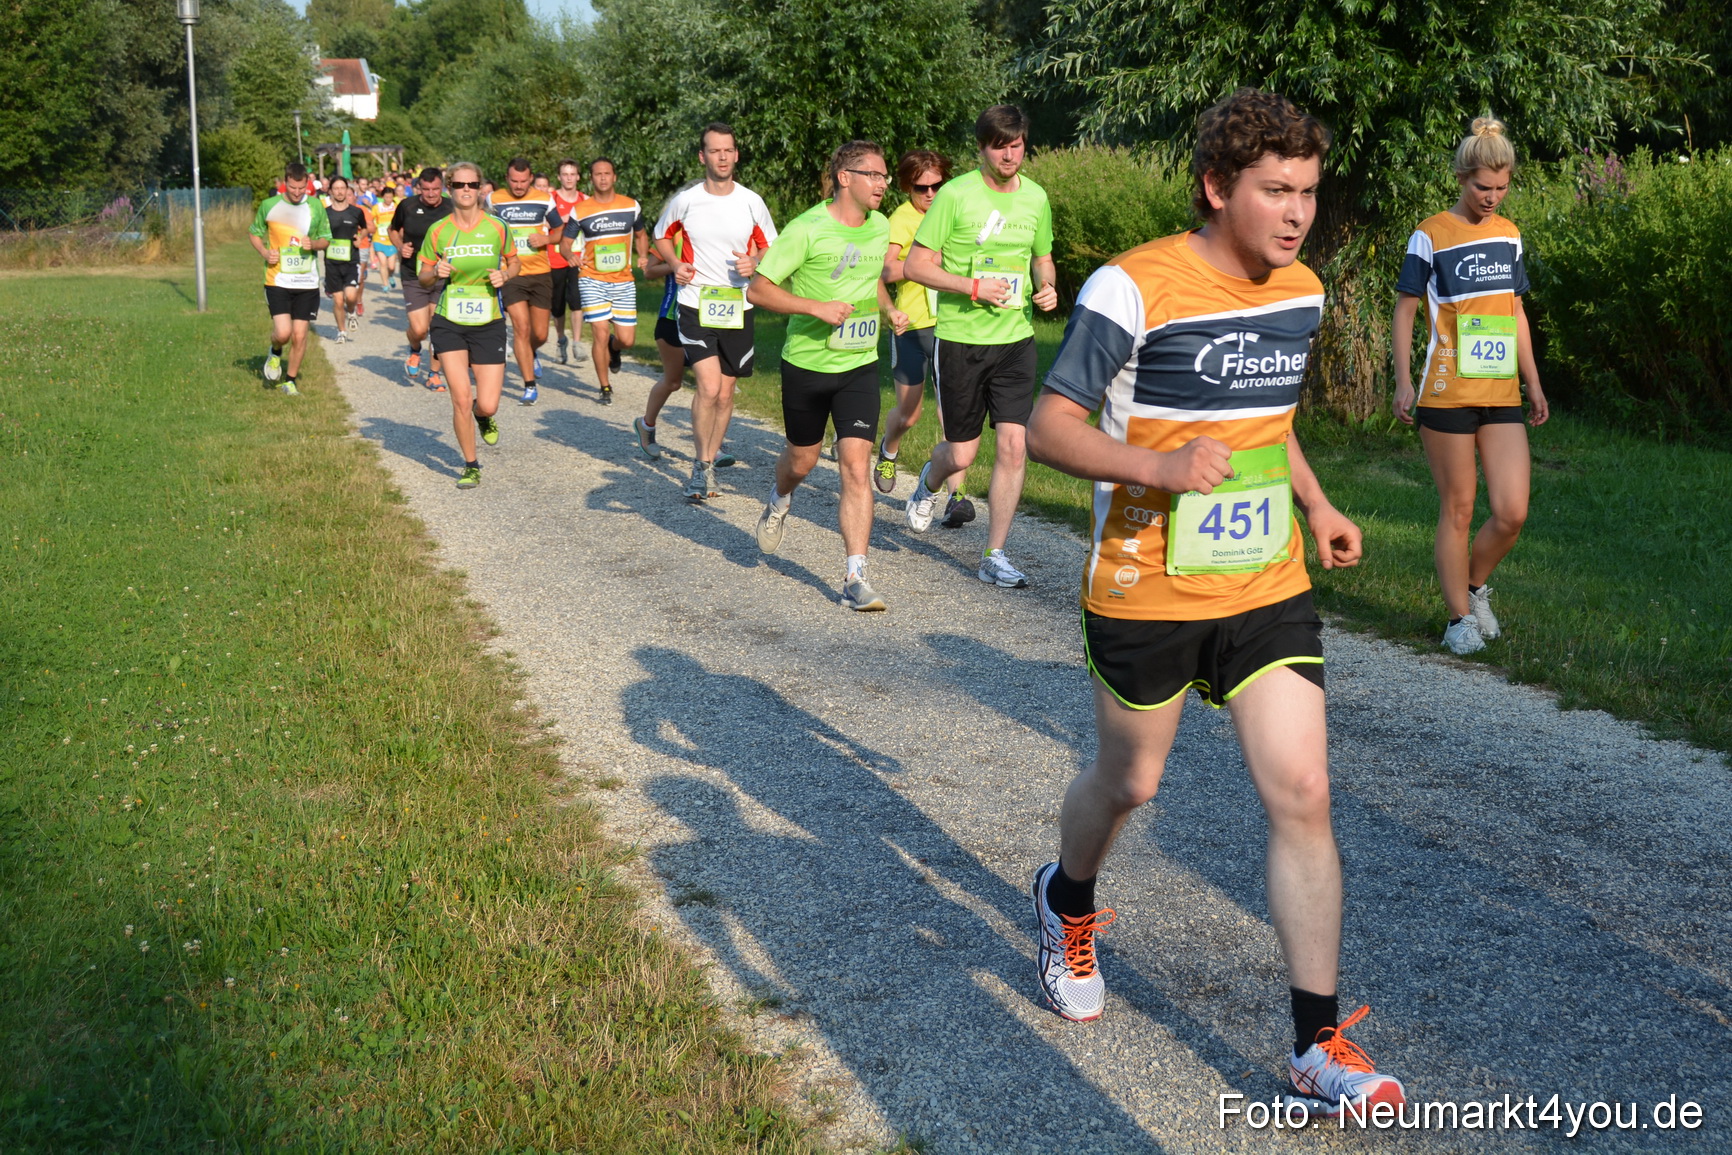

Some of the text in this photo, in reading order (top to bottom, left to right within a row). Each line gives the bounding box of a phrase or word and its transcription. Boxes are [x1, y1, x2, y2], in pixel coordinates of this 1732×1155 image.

[596, 221, 626, 229] Fischer
[332, 247, 345, 255] 103
[445, 245, 494, 258] BOCK
[287, 257, 305, 266] 987
[602, 255, 621, 264] 409
[1468, 261, 1511, 276] Fischer
[457, 301, 483, 314] 154
[708, 303, 734, 316] 824
[838, 320, 876, 338] 1100
[1470, 340, 1506, 361] 429
[1221, 350, 1307, 376] Fischer
[1242, 474, 1263, 485] 2015
[1198, 497, 1269, 540] 451
[1212, 547, 1263, 557] Dominik Götz
